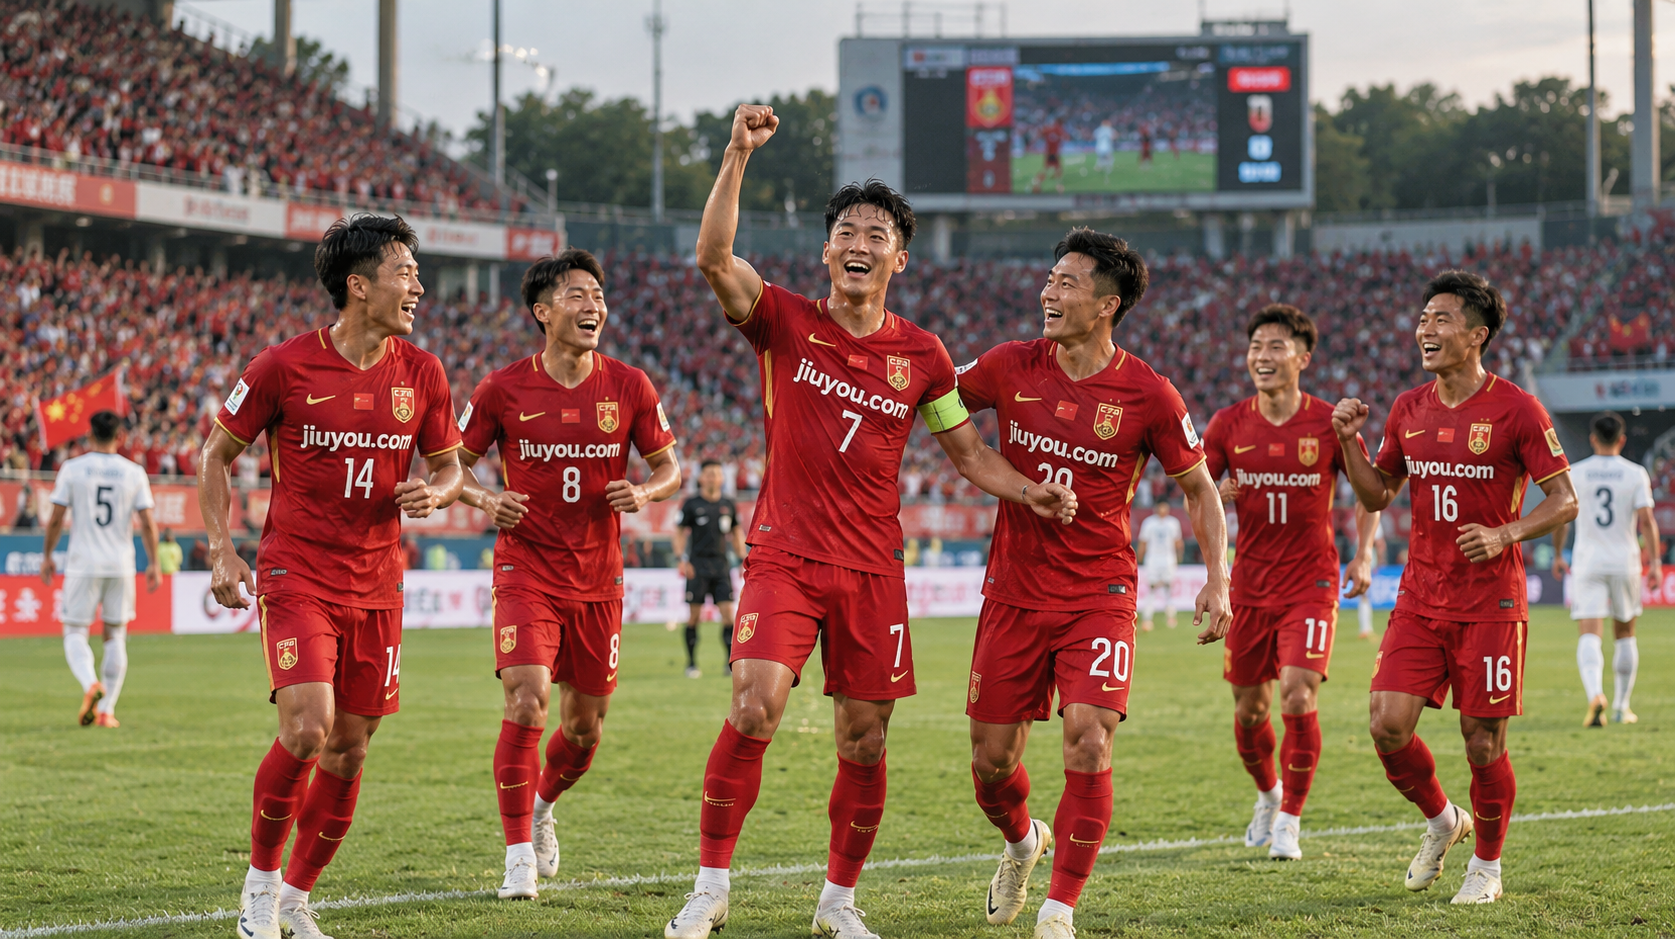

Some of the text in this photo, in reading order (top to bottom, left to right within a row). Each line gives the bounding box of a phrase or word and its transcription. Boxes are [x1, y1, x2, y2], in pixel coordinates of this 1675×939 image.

[793, 358, 909, 420] jiuyou.com
[300, 424, 413, 452] jiuyou.com
[518, 439, 621, 462] jiuyou.com
[838, 409, 863, 453] 7
[1009, 420, 1118, 468] jiuyou.com
[344, 457, 375, 499] 14
[562, 466, 581, 503] 8
[1235, 468, 1321, 489] jiuyou.com
[96, 486, 113, 527] 5
[1266, 492, 1288, 524] 11
[1431, 484, 1459, 522] 16
[1595, 487, 1614, 527] 3
[609, 633, 620, 670] 8
[889, 623, 904, 668] 7
[1305, 618, 1328, 651] 11
[384, 643, 401, 687] 14
[1089, 637, 1130, 682] 20
[1483, 655, 1512, 692] 16
